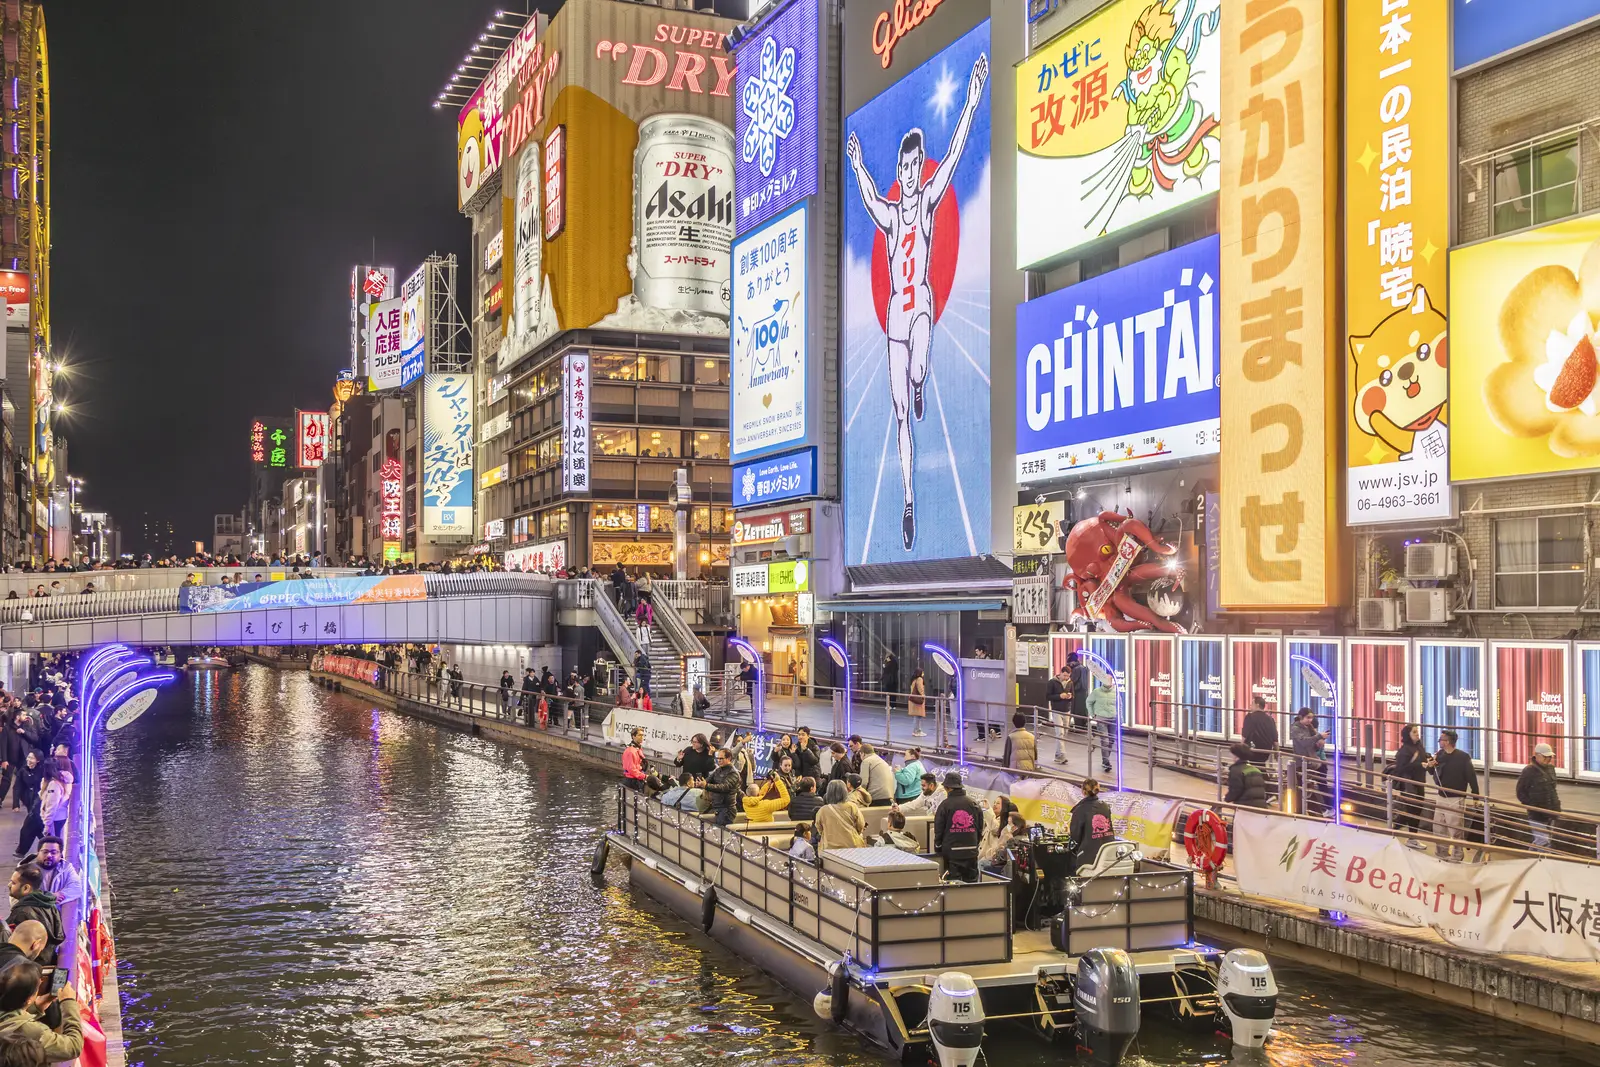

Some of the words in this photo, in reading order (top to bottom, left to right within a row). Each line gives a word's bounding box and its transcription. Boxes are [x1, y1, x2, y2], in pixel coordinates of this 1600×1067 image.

[1038, 38, 1102, 93] かぜに
[1030, 61, 1109, 149] 改源
[674, 151, 707, 162] SUPER
[645, 180, 732, 226] Asahi
[743, 168, 798, 217] 雪印メグミルク
[679, 225, 701, 242] 生
[664, 255, 716, 267] スーパードライ
[740, 227, 798, 276] 創業100周年
[901, 226, 916, 312] グリコ
[747, 262, 790, 300] ありがとう
[375, 309, 400, 333] 入店
[1026, 268, 1214, 432] CHINTAI
[748, 365, 790, 389] Anniversary
[573, 378, 585, 421] 本場の味
[572, 424, 586, 487] かに道楽
[756, 474, 801, 497] 雪印メグミルク
[1358, 469, 1438, 490] www.jsv.jp
[380, 459, 401, 537] 大阪王将
[1357, 492, 1440, 511] 06-4963-3661
[744, 523, 784, 541] ZETTERIA
[244, 621, 337, 635] えびす橋
[1459, 687, 1478, 698] Street
[1541, 691, 1561, 703] Street
[1526, 700, 1563, 713] Illuminated
[1310, 842, 1340, 878] 美
[1345, 854, 1482, 918] Beauiful
[1440, 926, 1481, 941] ERSITY
[1250, 977, 1267, 988] 115
[952, 1001, 970, 1013] 115
[1113, 996, 1131, 1004] 150
